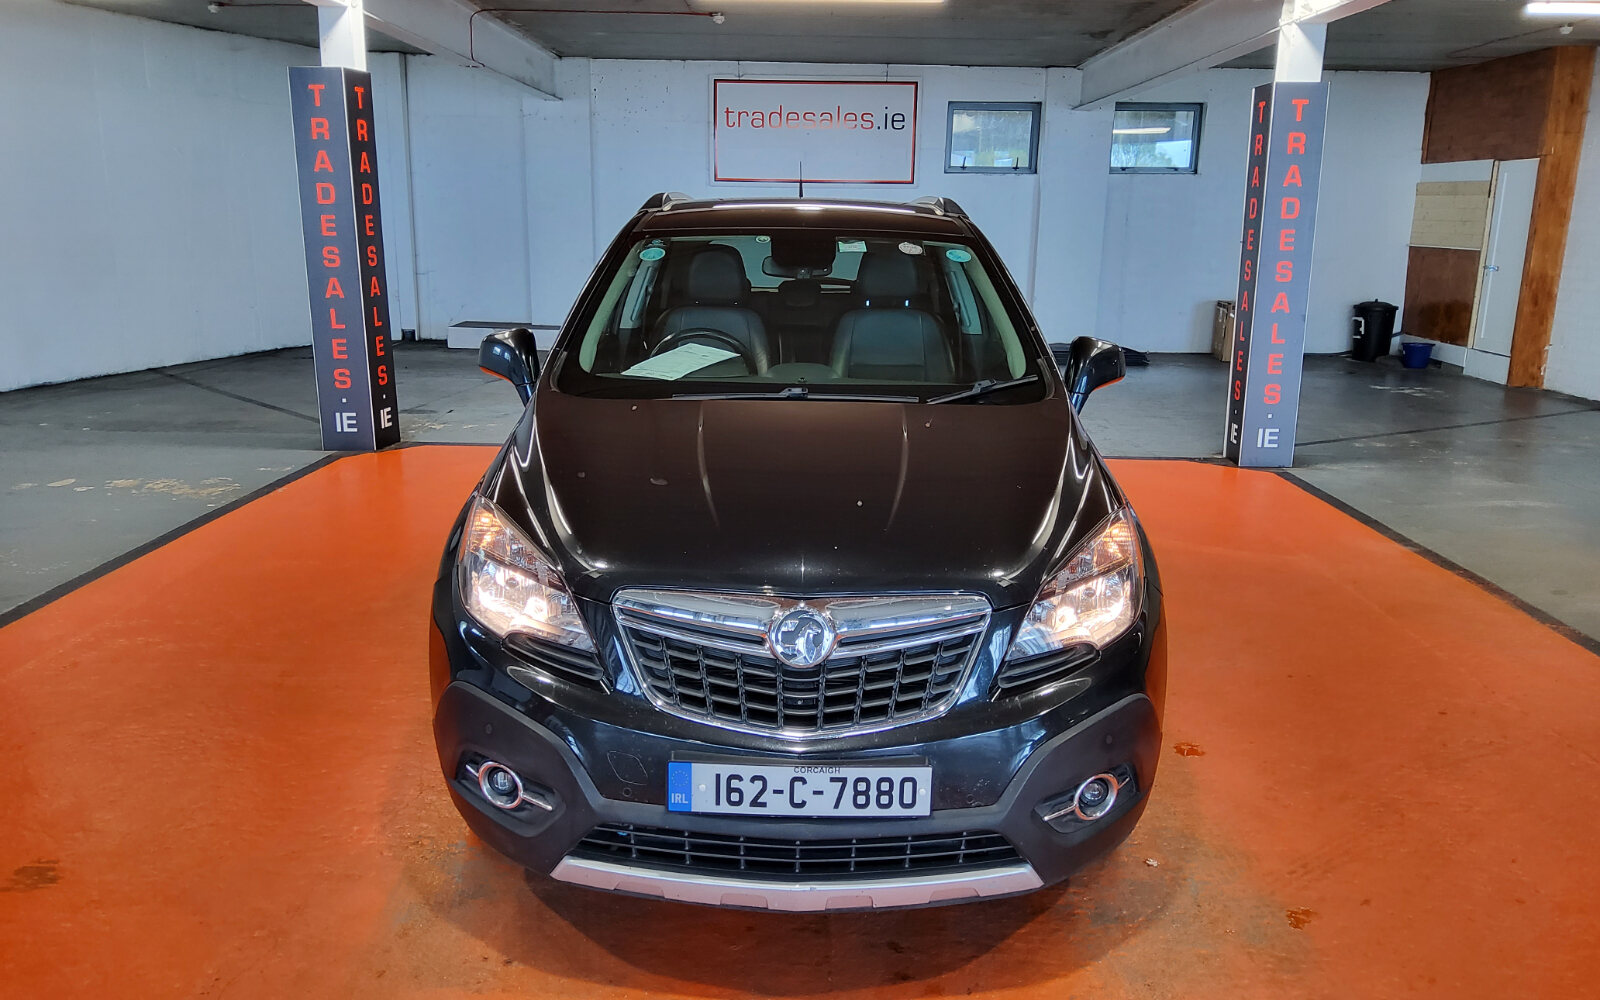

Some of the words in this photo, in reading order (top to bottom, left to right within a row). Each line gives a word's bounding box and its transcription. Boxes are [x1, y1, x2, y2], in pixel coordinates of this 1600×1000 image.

[724, 104, 906, 130] tradesales.ie
[793, 766, 841, 774] CORCAIGH
[671, 792, 688, 804] IRL
[715, 773, 918, 809] 162-C-7880
